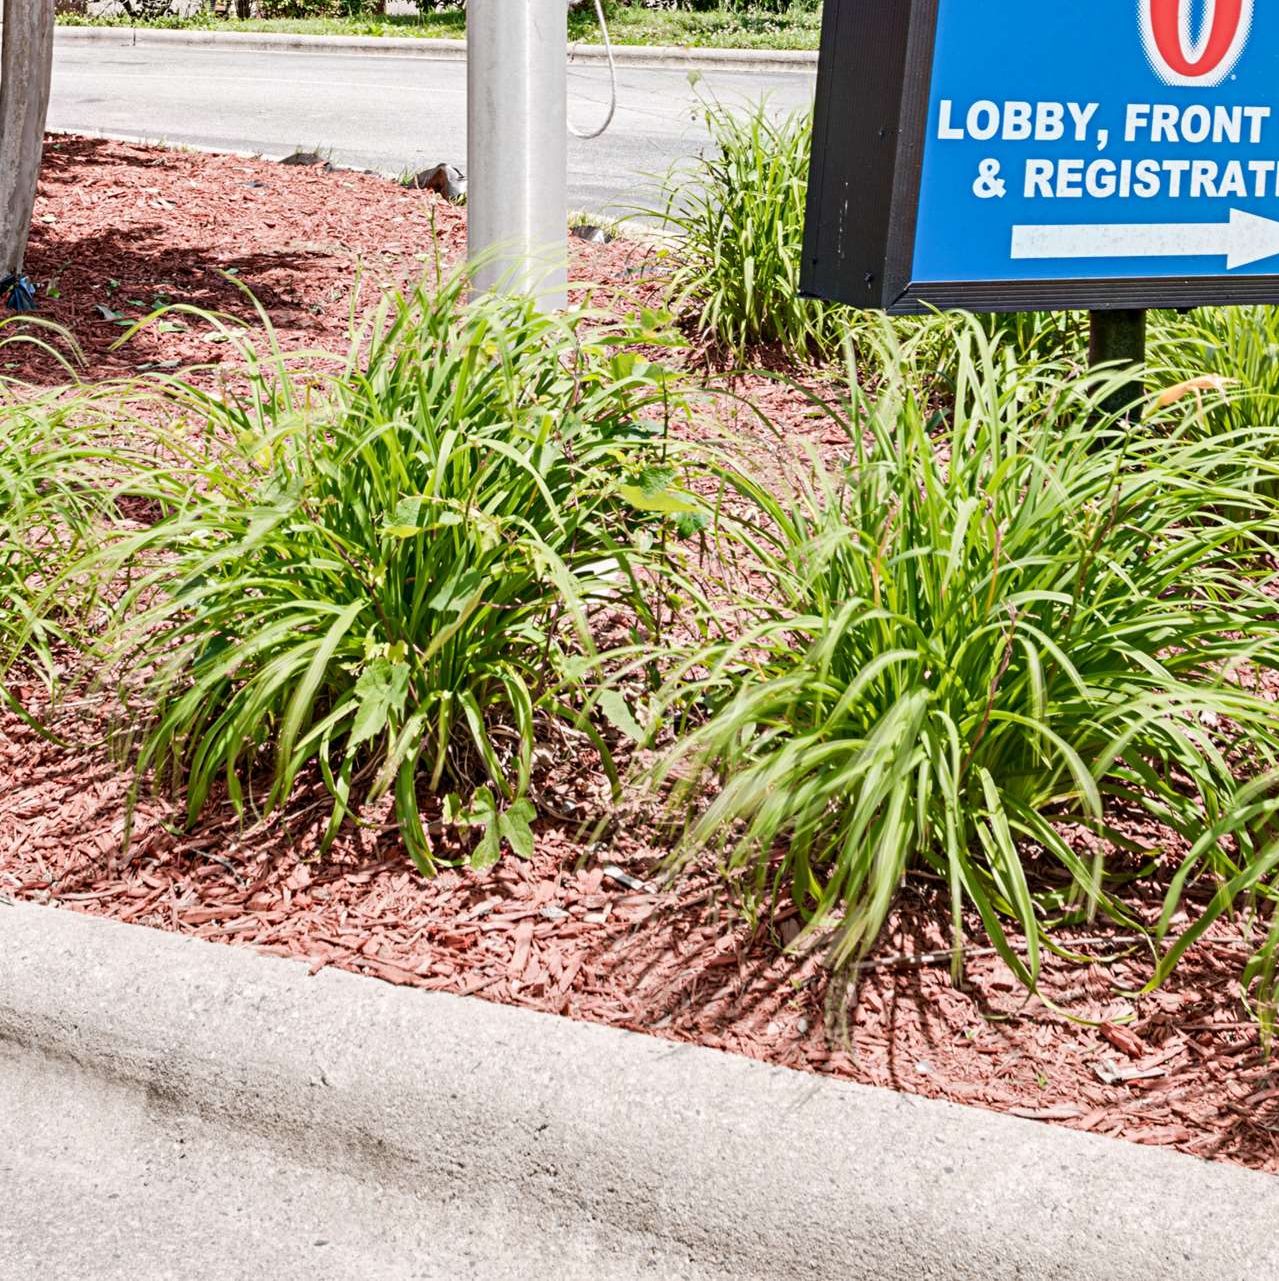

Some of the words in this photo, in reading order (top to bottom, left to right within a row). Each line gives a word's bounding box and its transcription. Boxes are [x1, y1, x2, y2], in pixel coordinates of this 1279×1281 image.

[938, 100, 1109, 151] LOBBY,
[1124, 103, 1271, 144] FRONT
[971, 158, 1007, 198] &
